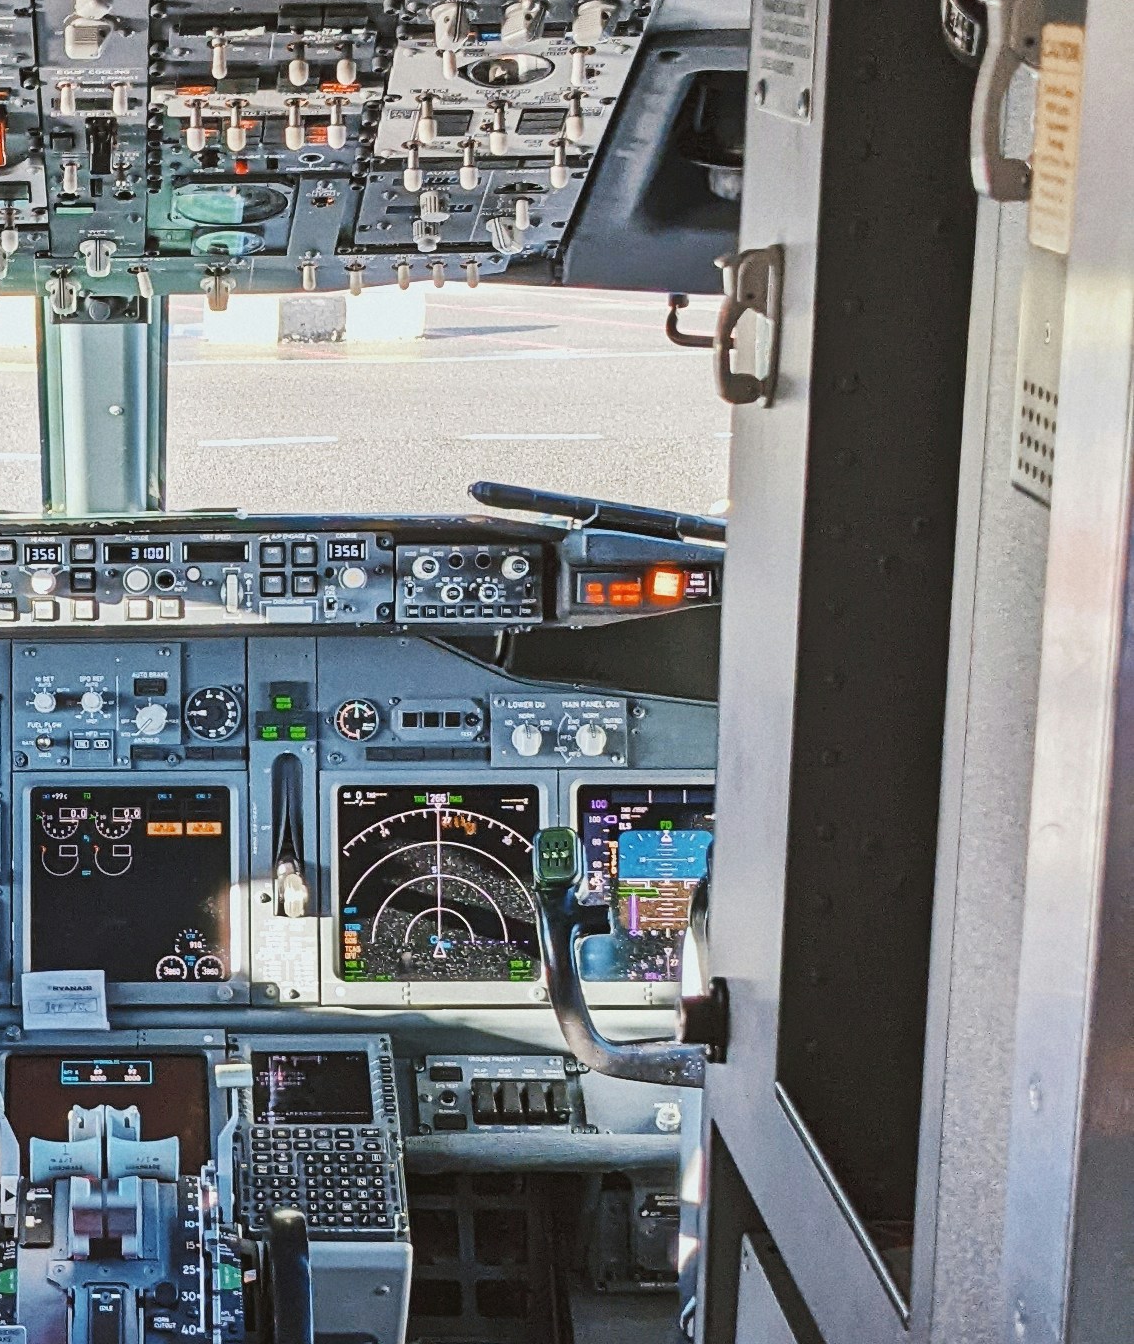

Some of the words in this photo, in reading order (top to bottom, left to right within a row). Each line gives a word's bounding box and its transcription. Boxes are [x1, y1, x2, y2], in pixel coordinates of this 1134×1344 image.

[32, 548, 56, 561] 356
[334, 545, 359, 557] 356
[71, 809, 87, 818] 0.0
[123, 809, 140, 818] 0.0
[182, 1266, 196, 1274] 25
[181, 1292, 196, 1300] 30
[181, 1326, 197, 1335] 40
